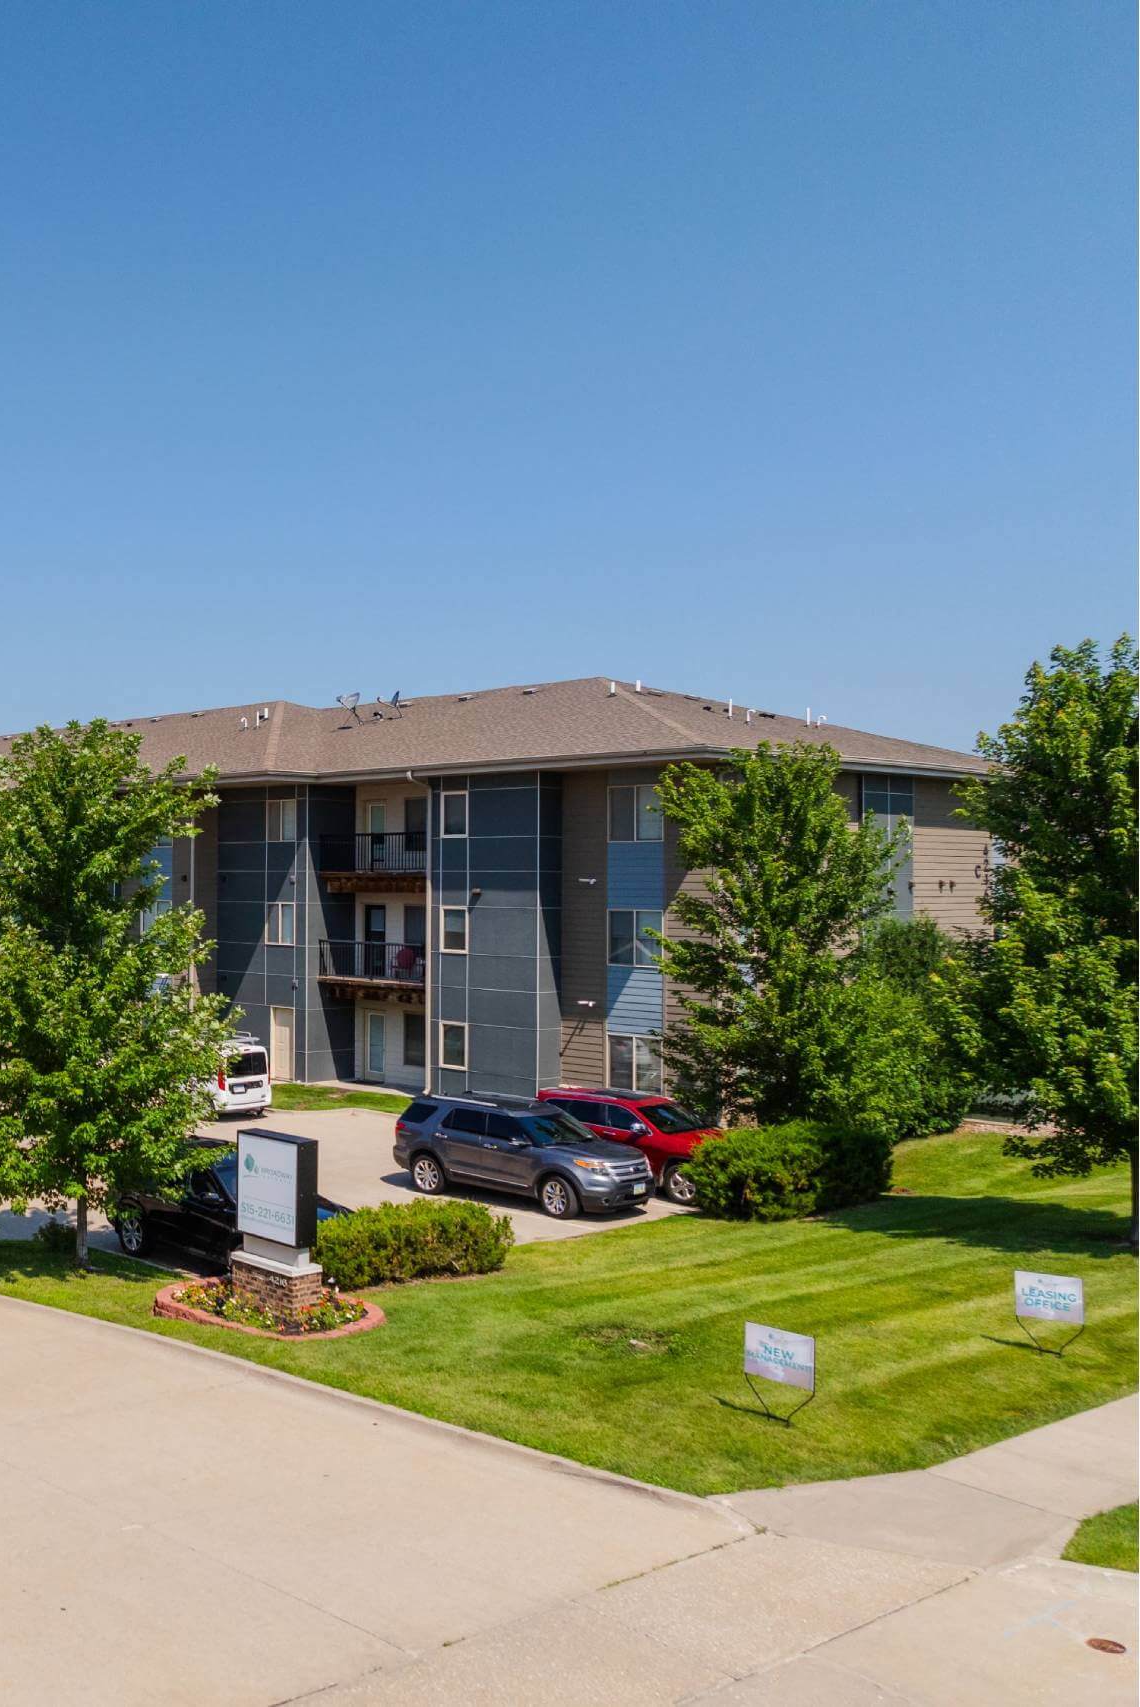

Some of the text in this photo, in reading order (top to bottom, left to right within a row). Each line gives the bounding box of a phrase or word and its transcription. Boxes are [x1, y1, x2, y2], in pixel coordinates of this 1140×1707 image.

[1021, 1285, 1077, 1303] LEASING
[1024, 1297, 1071, 1312] OFFICE
[763, 1344, 796, 1361] NEW
